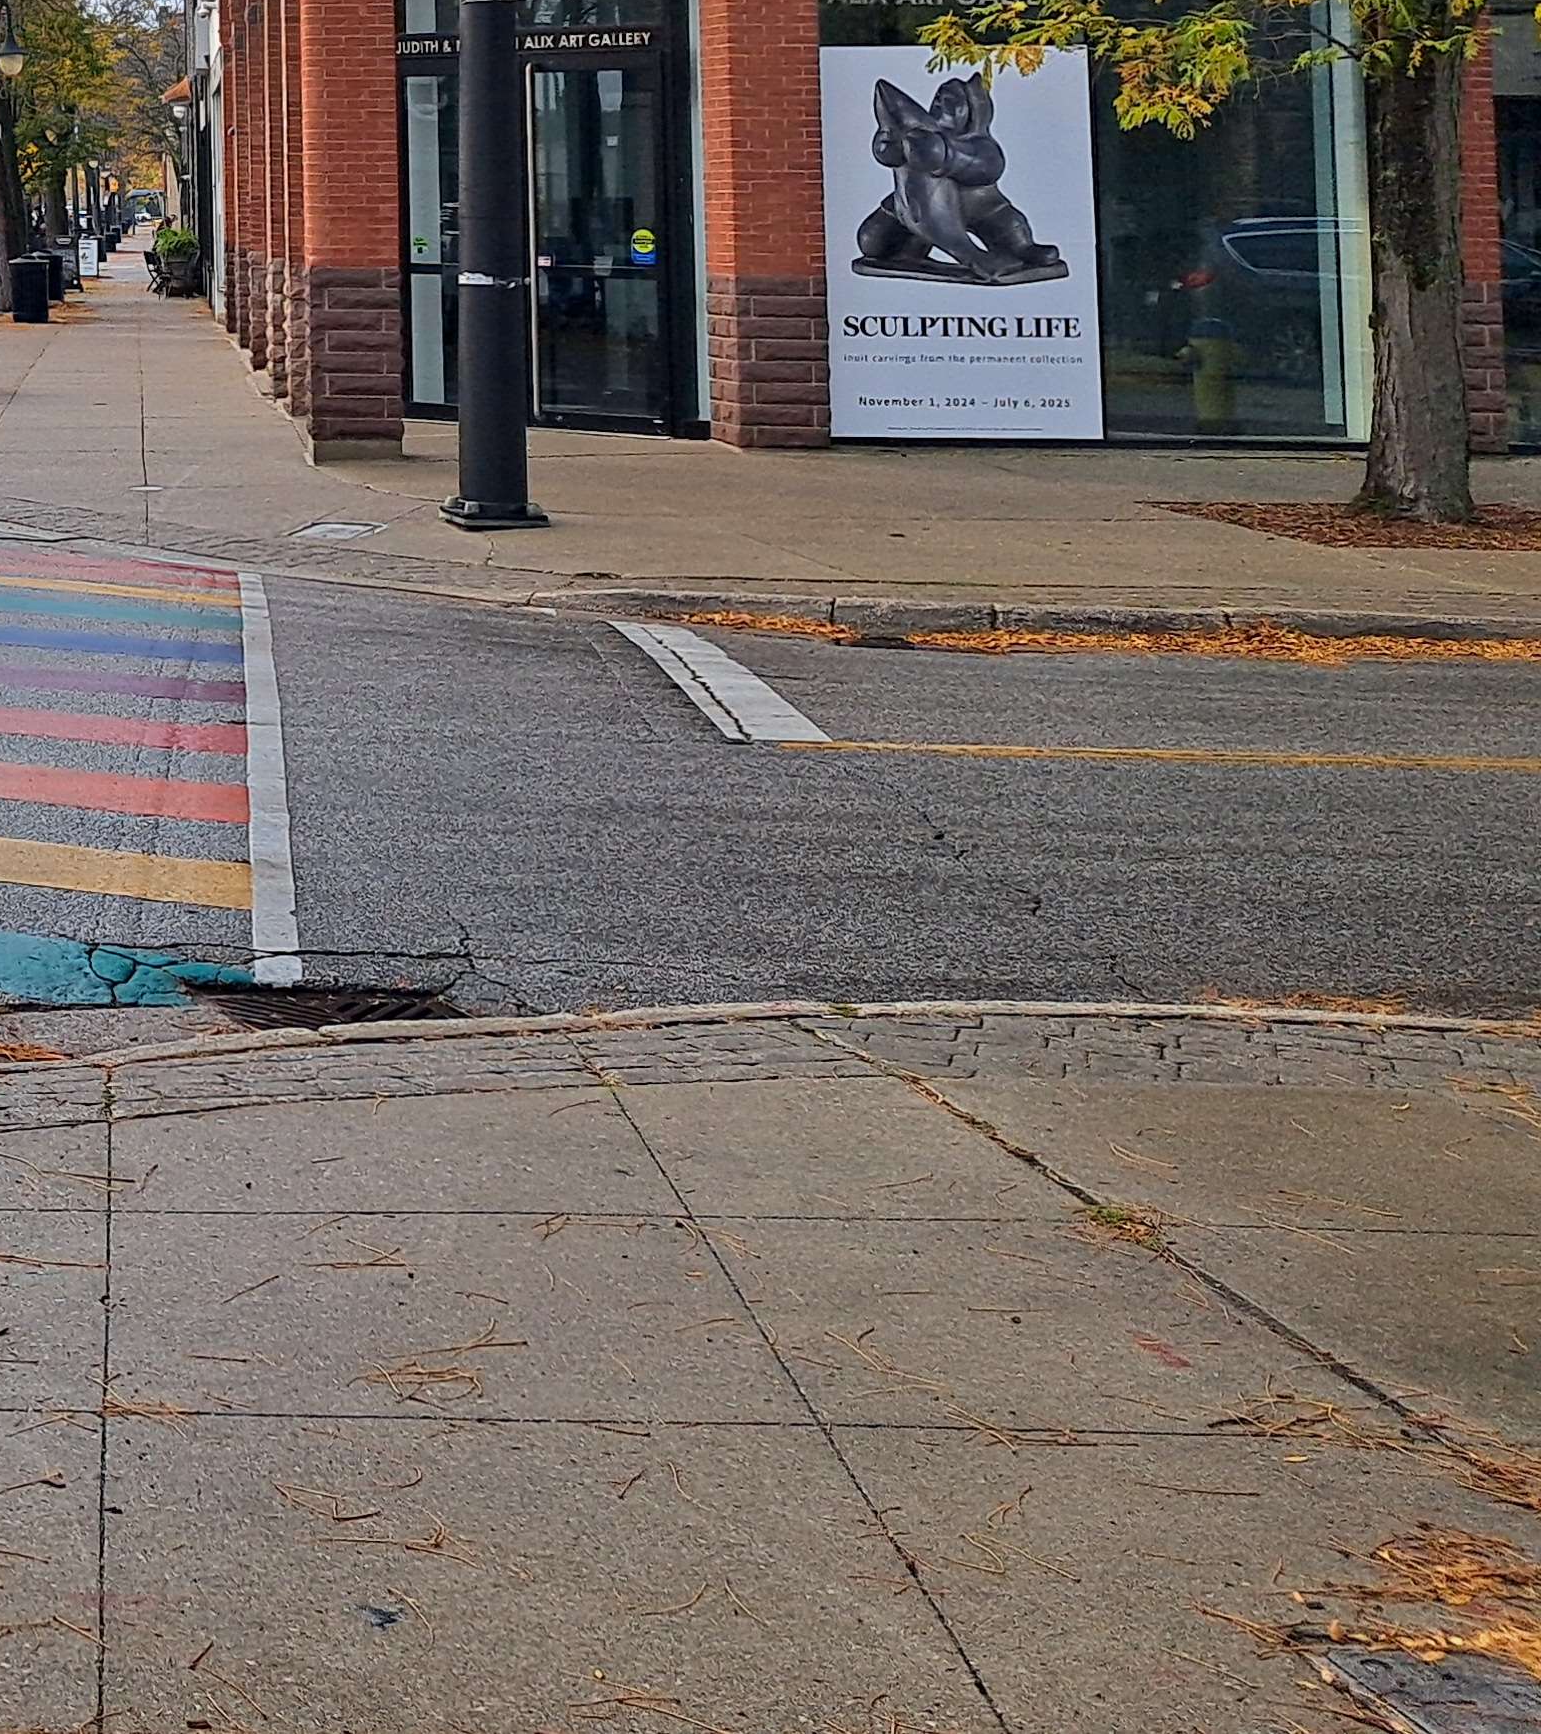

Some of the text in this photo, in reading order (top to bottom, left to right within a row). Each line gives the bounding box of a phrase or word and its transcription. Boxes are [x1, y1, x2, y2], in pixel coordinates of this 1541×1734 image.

[395, 40, 439, 55] JUDITH
[442, 39, 452, 53] &
[523, 35, 553, 50] ALIX
[558, 34, 586, 49] ART
[588, 31, 652, 47] GALLERY
[843, 315, 1082, 339] SCULPTING LIFE
[872, 354, 917, 364] carvings
[920, 353, 945, 363] from
[949, 353, 966, 364] the
[969, 355, 1027, 365] permanent
[1030, 354, 1084, 365] collection
[858, 396, 924, 407] November
[929, 397, 941, 409] 1,
[945, 397, 976, 408] 2024
[993, 397, 1018, 410] July
[1040, 398, 1071, 408] 2025
